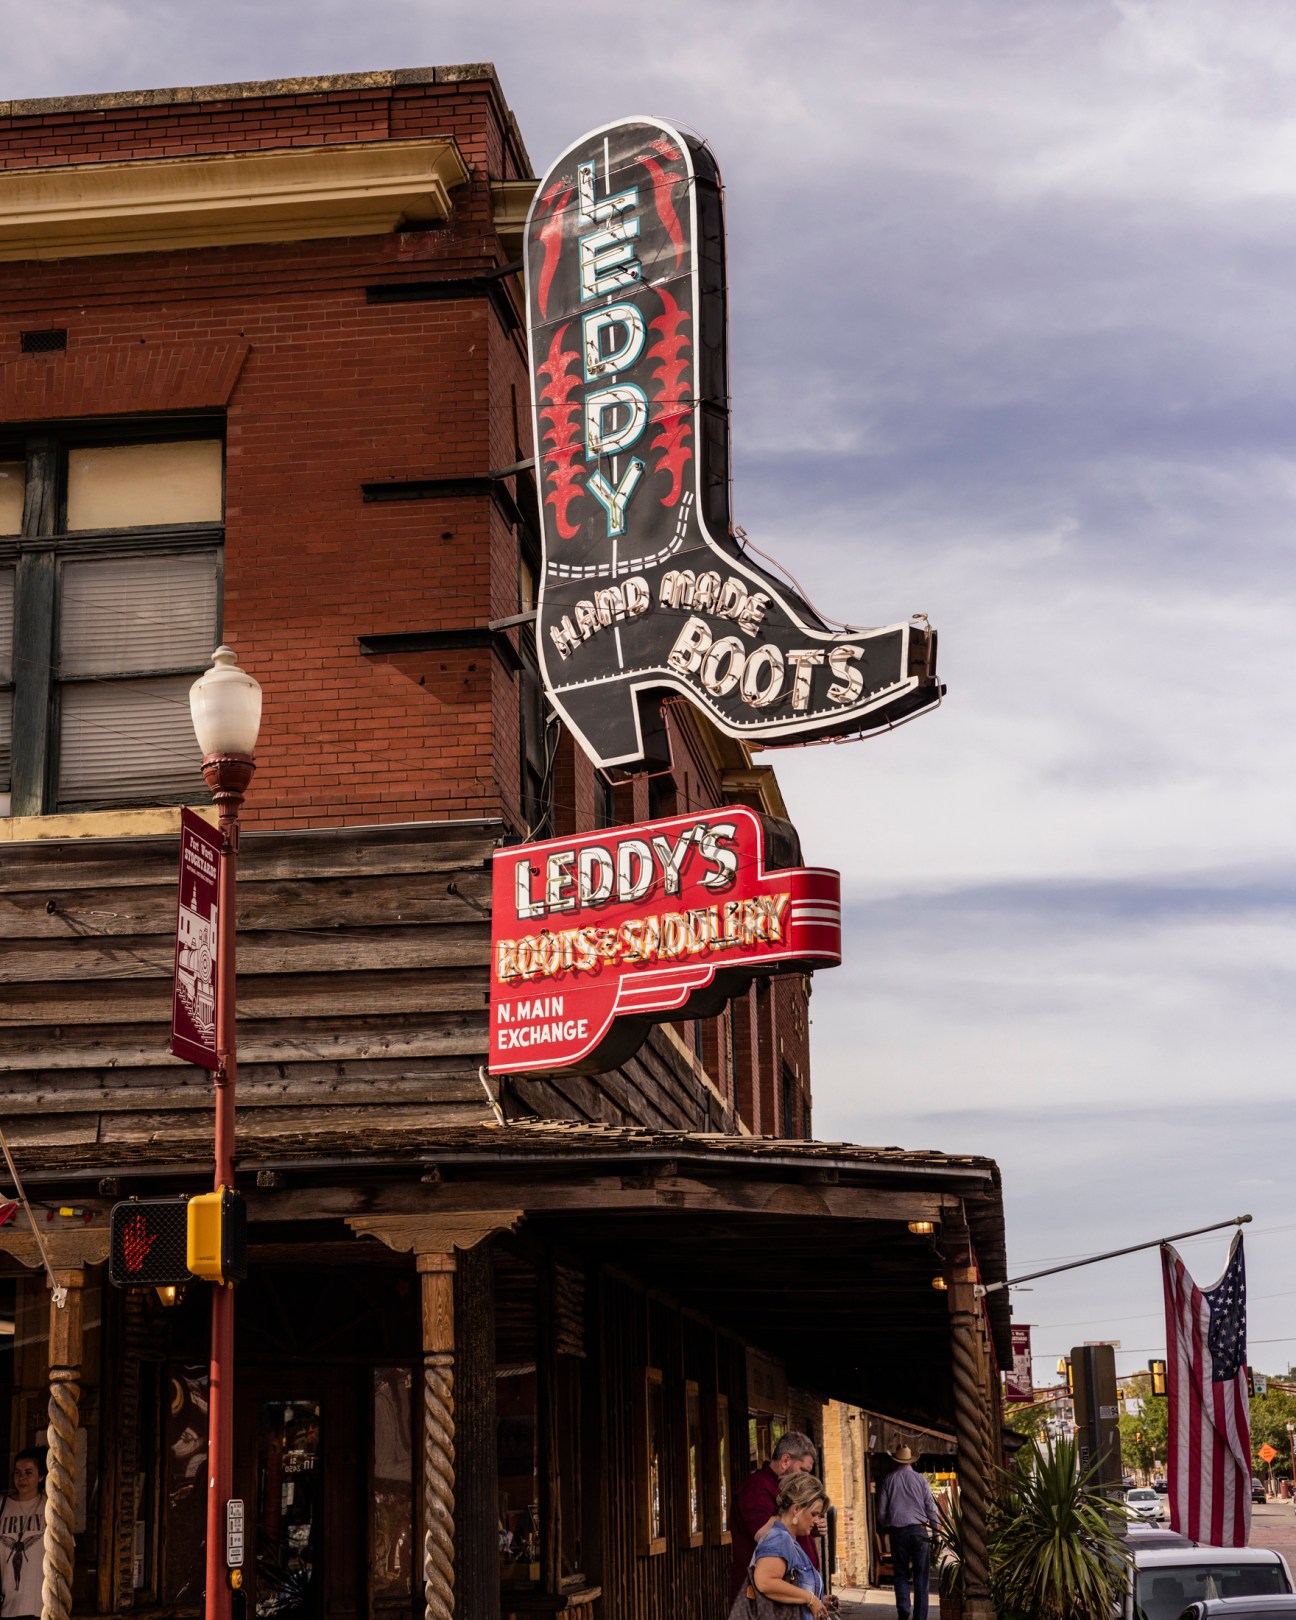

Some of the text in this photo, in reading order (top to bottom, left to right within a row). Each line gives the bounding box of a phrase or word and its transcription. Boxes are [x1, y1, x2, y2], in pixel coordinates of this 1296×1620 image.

[578, 159, 649, 537] LEDDY
[550, 570, 771, 660] HAND MADE
[667, 615, 866, 710] BOOTS
[515, 822, 738, 920] LEDDY'S
[495, 928, 597, 983] BOOTS
[620, 892, 791, 962] SADDLERY
[497, 1019, 589, 1051] EXCHANGE
